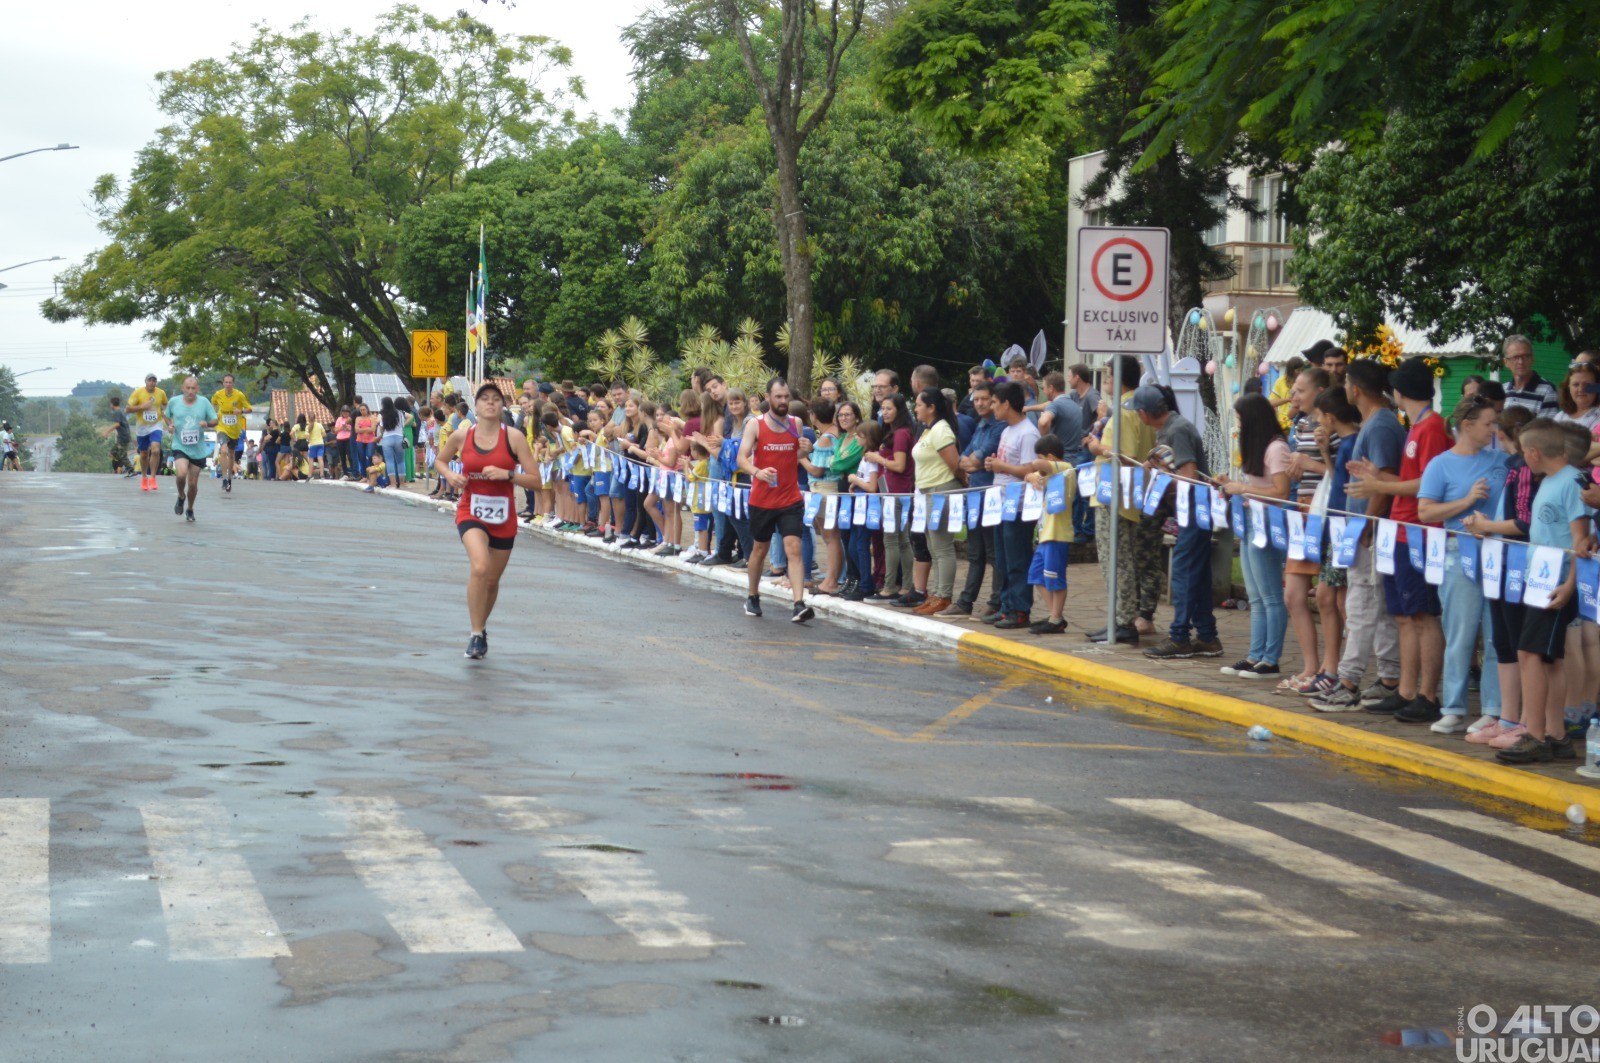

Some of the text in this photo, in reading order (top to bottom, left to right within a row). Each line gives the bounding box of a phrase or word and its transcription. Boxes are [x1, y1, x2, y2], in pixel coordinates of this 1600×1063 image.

[1112, 253, 1132, 286] E
[1083, 310, 1159, 323] EXCLUSIVO
[1106, 324, 1136, 341] TÁXI
[182, 434, 198, 443] 521
[474, 506, 505, 520] 624
[1483, 572, 1499, 582] anrisul
